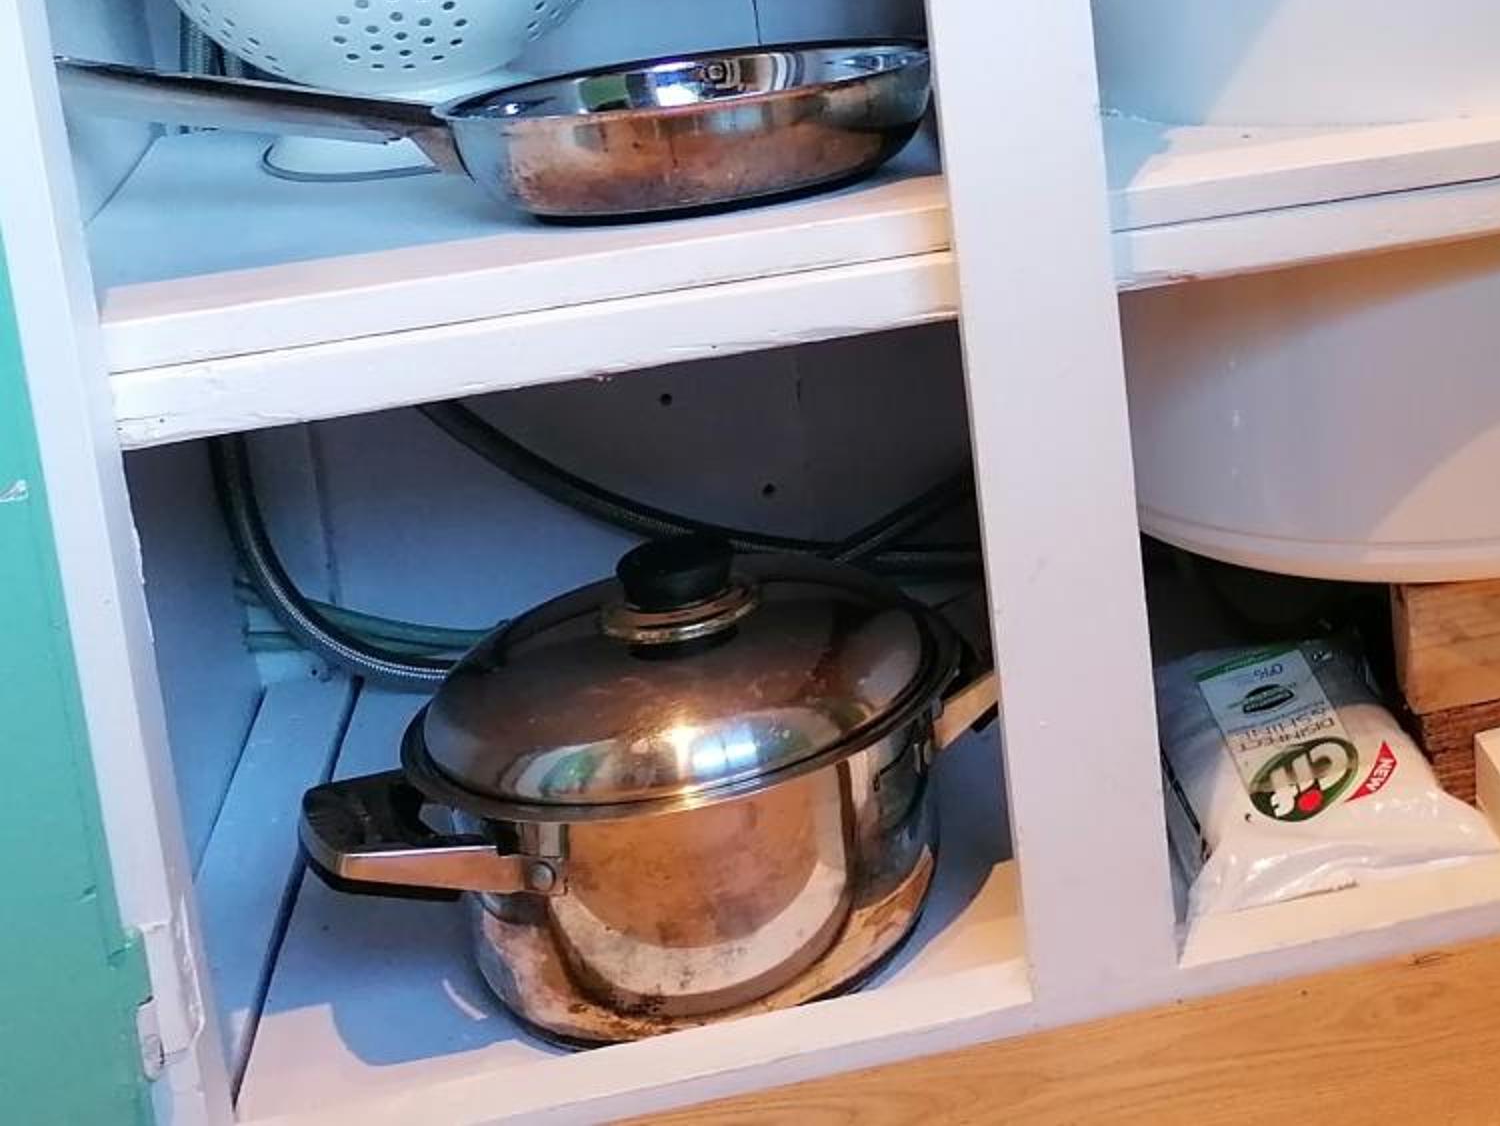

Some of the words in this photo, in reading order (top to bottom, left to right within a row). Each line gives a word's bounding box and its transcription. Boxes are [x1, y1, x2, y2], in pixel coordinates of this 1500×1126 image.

[1237, 716, 1335, 752] DISINFECT
[1269, 741, 1348, 818] Cif
[1365, 757, 1395, 792] NEW
